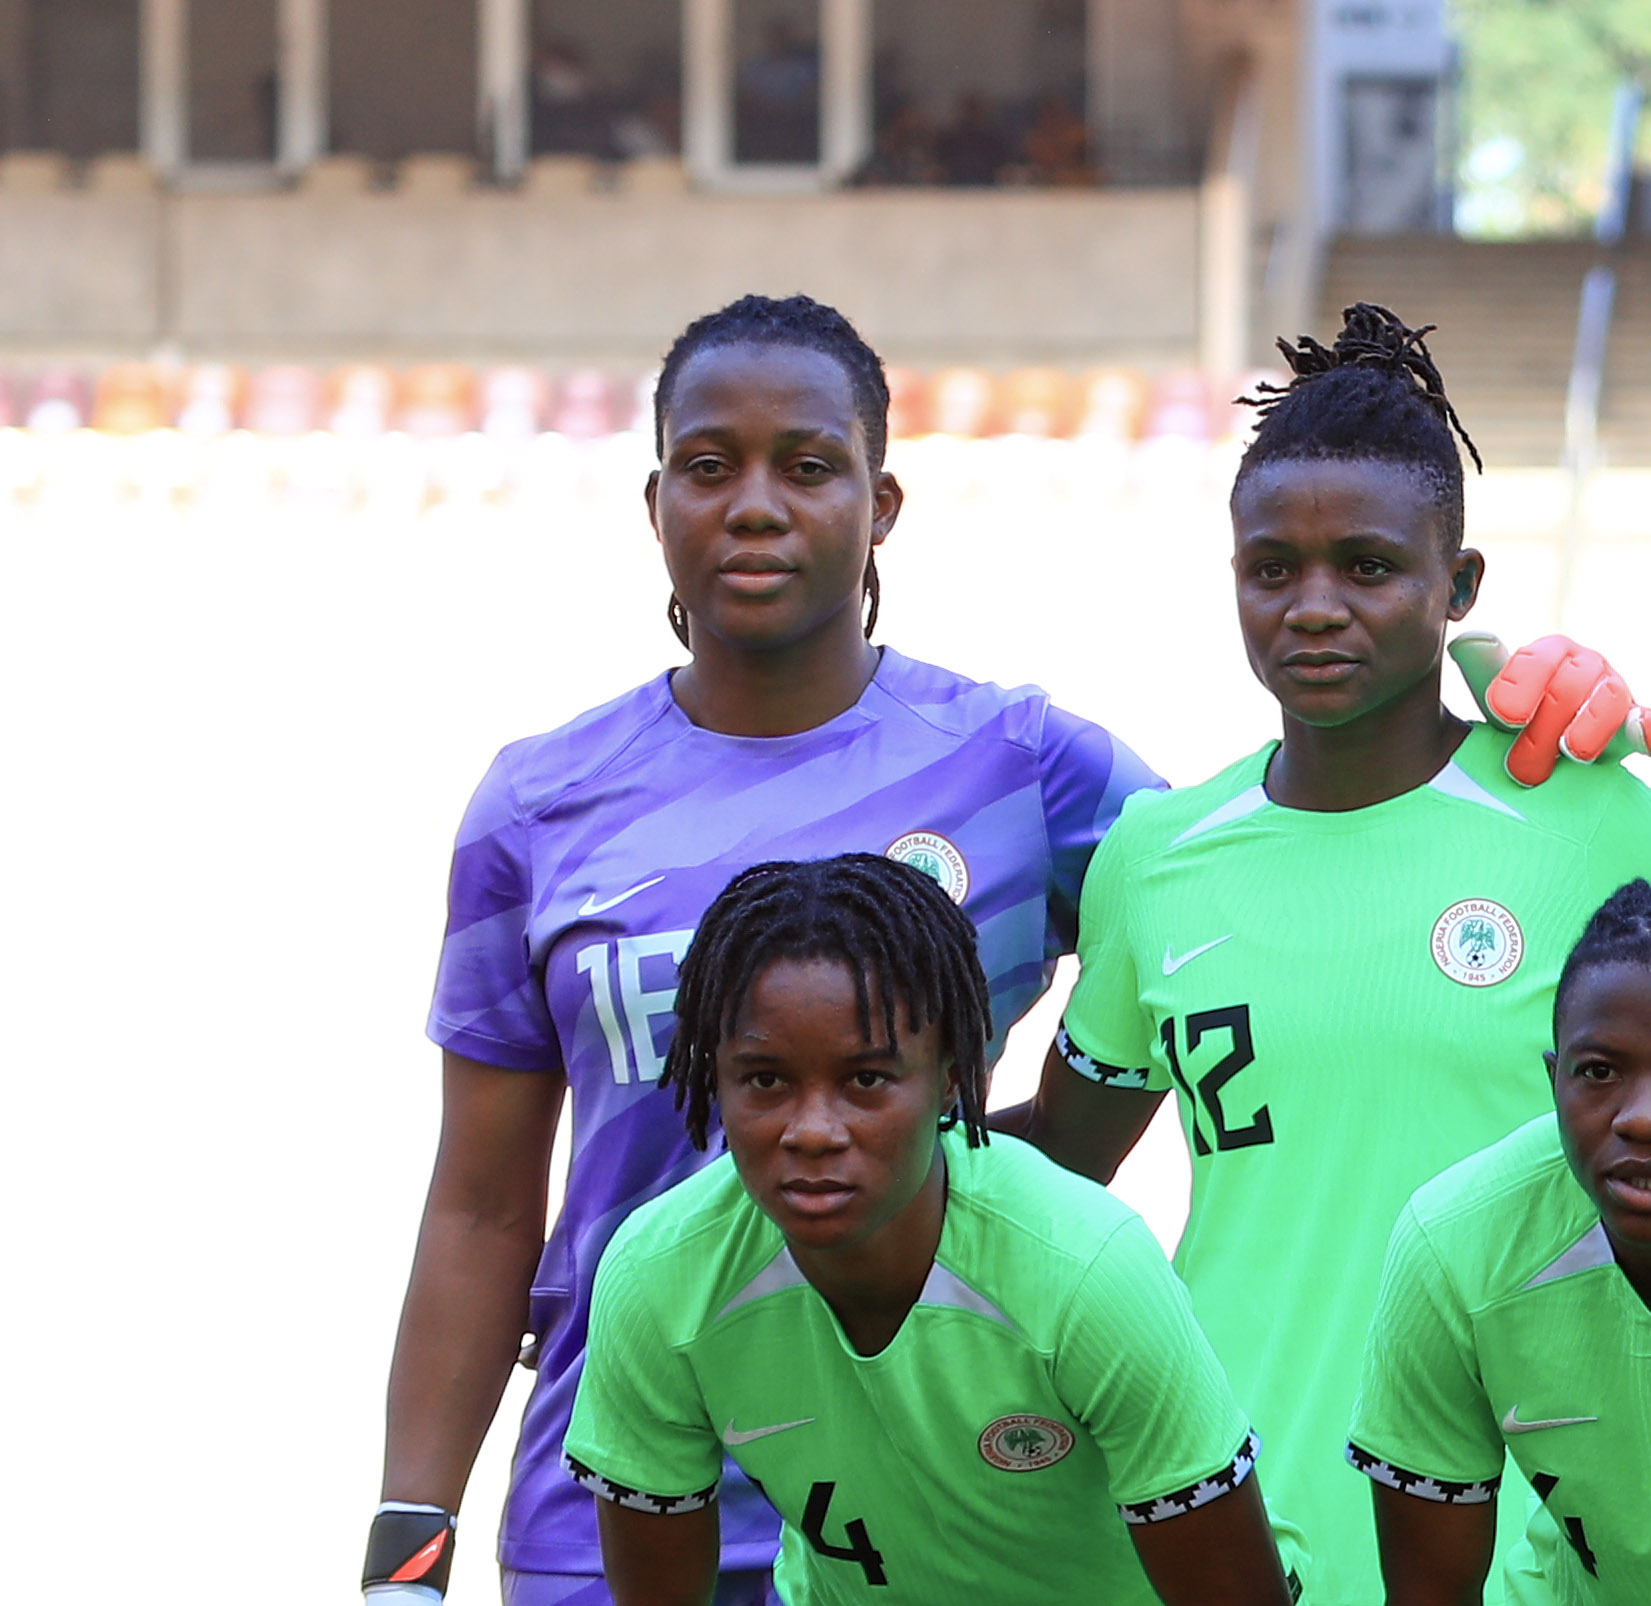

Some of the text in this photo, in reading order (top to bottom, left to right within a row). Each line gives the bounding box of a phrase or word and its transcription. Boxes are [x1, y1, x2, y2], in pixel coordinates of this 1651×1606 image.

[1436, 904, 1519, 974] NIGERIA FOOTBALL FEDERATION
[1463, 972, 1486, 982] 1945
[1159, 1003, 1275, 1158] 12
